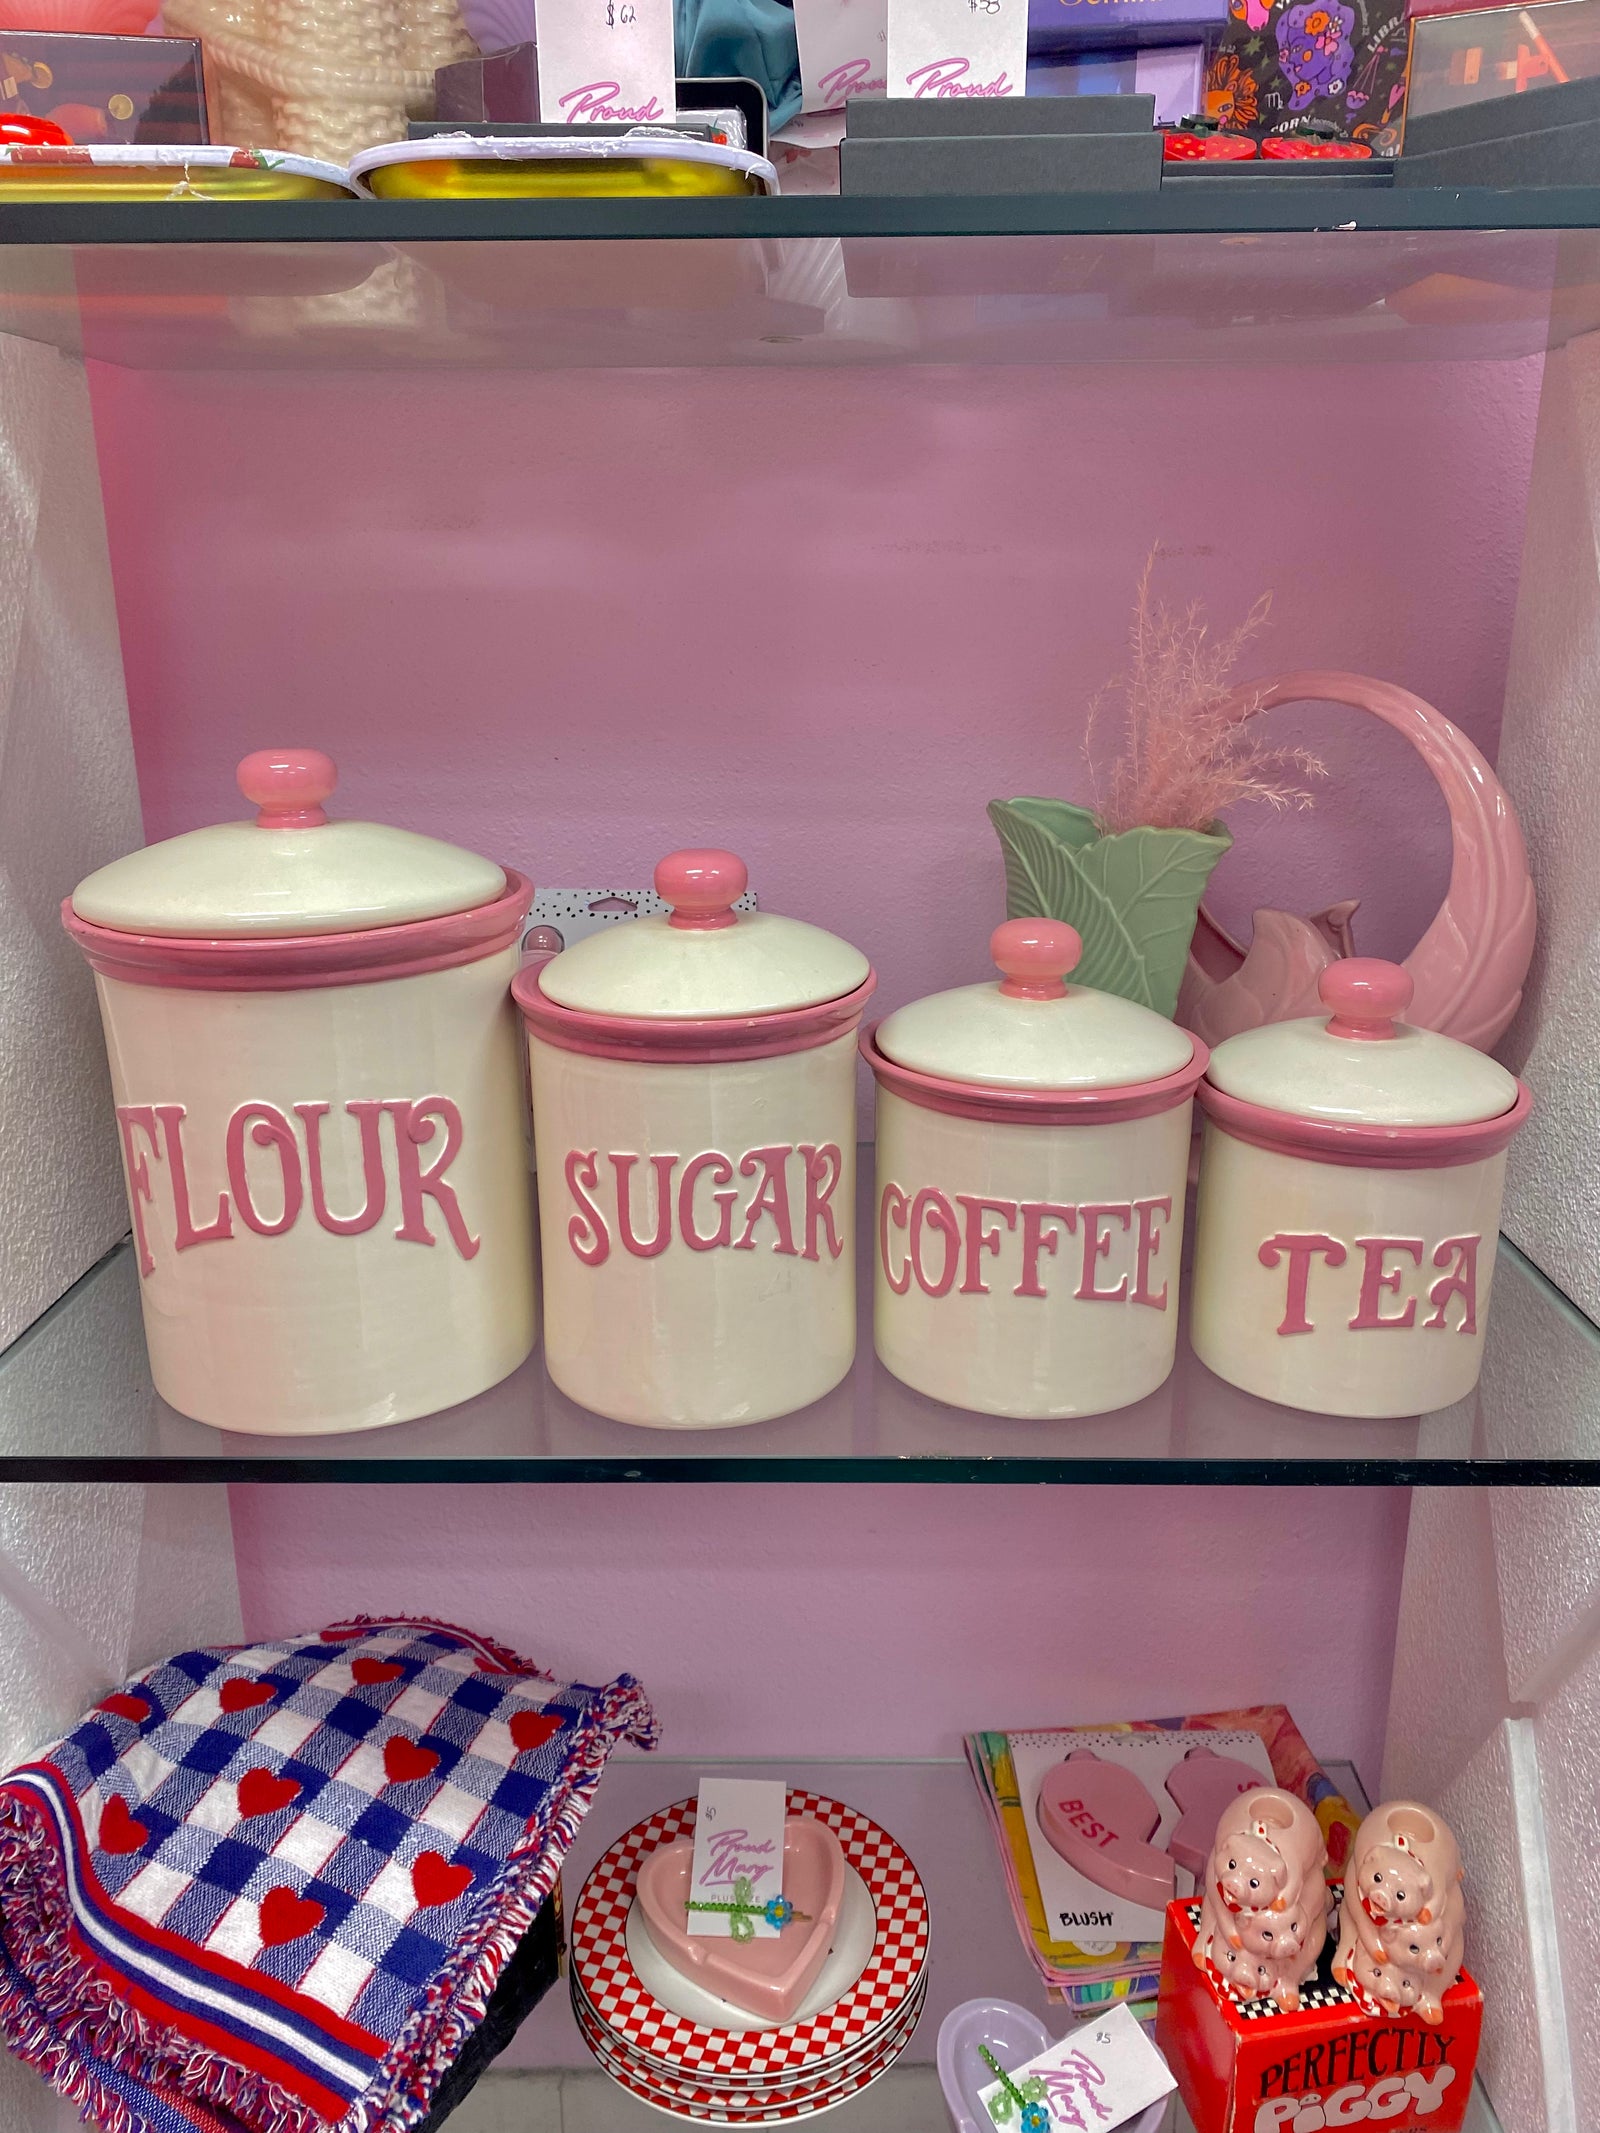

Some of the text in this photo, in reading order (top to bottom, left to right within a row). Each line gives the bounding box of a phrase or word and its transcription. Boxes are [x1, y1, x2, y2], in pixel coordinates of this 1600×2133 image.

[558, 81, 665, 124] Proud
[818, 58, 887, 103] Prou
[906, 57, 1014, 99] Proud
[116, 1095, 481, 1278] FLOUR
[564, 1143, 844, 1267] SUGAR
[880, 1182, 1173, 1312] COFFEE
[1258, 1231, 1482, 1335] TEA
[707, 1829, 776, 1857] Proud
[1058, 1799, 1119, 1848] BEST
[699, 1852, 775, 1887] Mary
[1059, 1911, 1113, 1927] BLUSH
[1061, 2049, 1113, 2121] Proud
[1260, 2027, 1456, 2099] PERFECTLY
